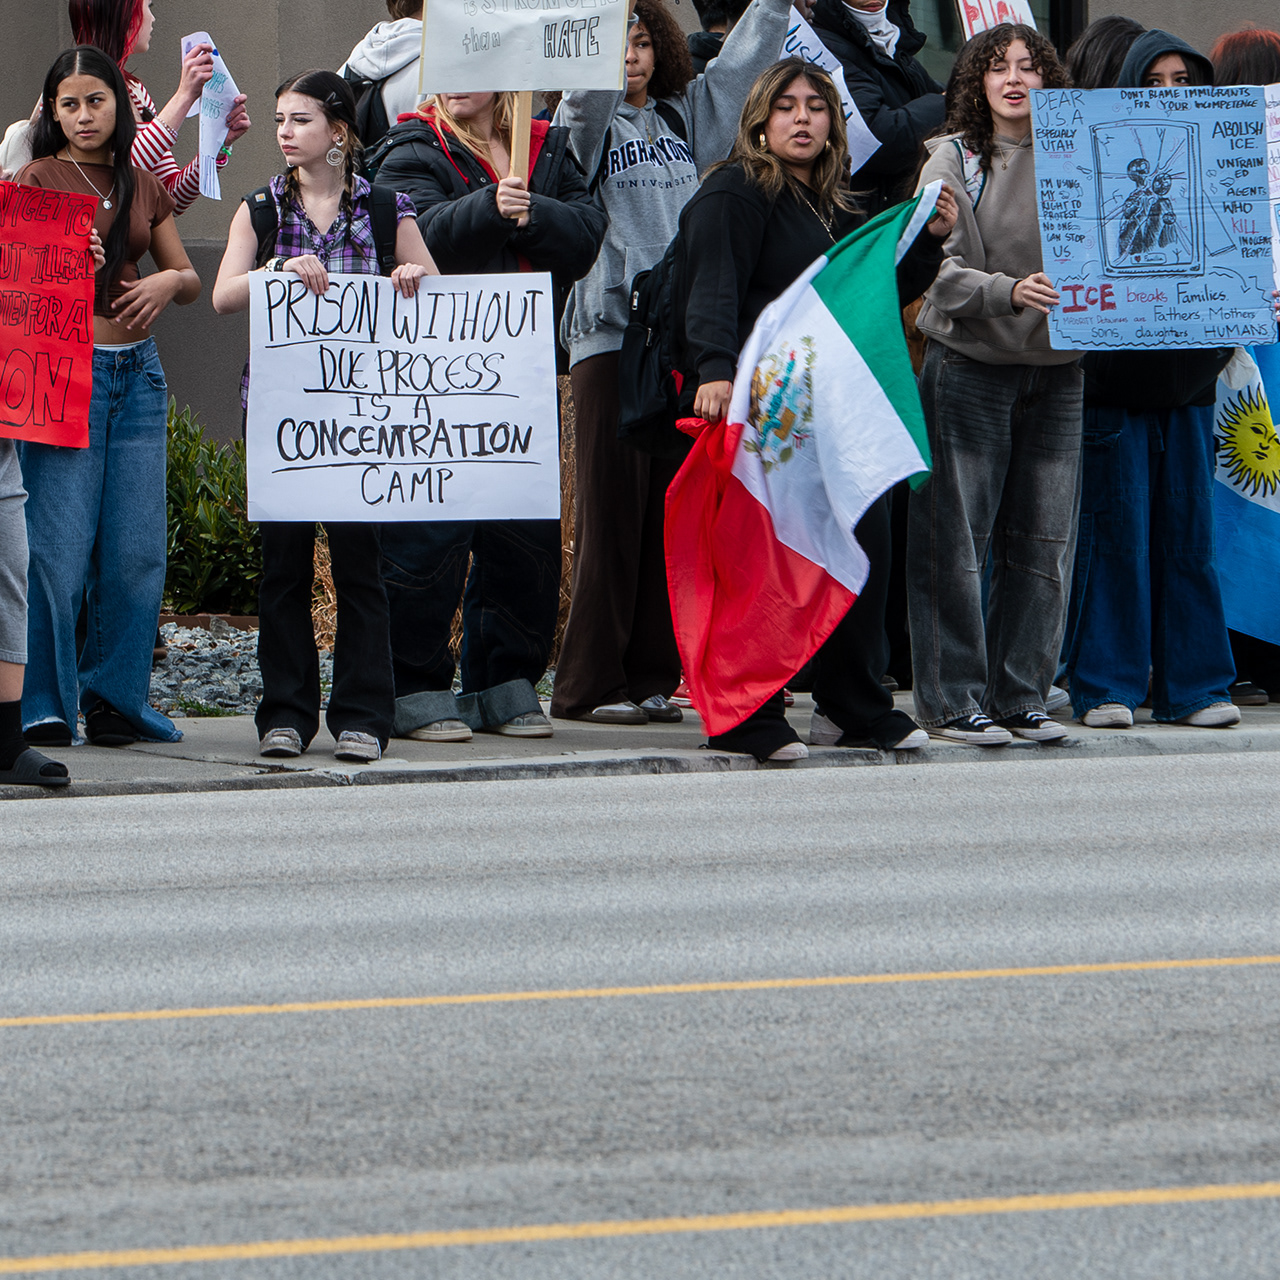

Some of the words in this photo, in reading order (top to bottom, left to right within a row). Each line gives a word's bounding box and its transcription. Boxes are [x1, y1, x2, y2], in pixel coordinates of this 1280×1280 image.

[462, 27, 501, 54] than
[543, 16, 600, 58] HATE
[1035, 89, 1085, 111] DEAR
[1121, 89, 1144, 100] DONT
[1149, 88, 1180, 99] BLAME
[1184, 87, 1250, 98] IMMIGRANTS
[1134, 100, 1150, 109] FOR
[1160, 100, 1188, 110] YOUR
[1212, 120, 1264, 138] ABOLISH
[1041, 140, 1075, 152] UTAH
[1216, 157, 1264, 169] UNTRAIN
[1235, 169, 1249, 178] ED
[1057, 179, 1080, 189] USING
[1040, 190, 1055, 200] MY
[1041, 200, 1069, 211] RIGHT
[1072, 200, 1082, 209] TO
[1223, 201, 1253, 214] WHO
[20, 189, 70, 222] GET
[64, 198, 95, 236] TO
[1043, 222, 1054, 231] NO
[1057, 222, 1072, 231] ONE
[1231, 217, 1259, 234] KILL
[1047, 233, 1062, 242] CAN
[1065, 233, 1085, 243] STOP
[1241, 247, 1272, 258] PEOPLE
[1061, 283, 1116, 313] ICE
[1126, 286, 1168, 303] breaks
[265, 279, 379, 343] PRISON
[391, 290, 544, 344] WITHOUT
[1209, 308, 1256, 320] Mothers
[22, 293, 63, 337] FOR
[59, 299, 90, 344] A
[320, 344, 369, 391] DUE
[375, 349, 505, 395] PROCESS
[349, 395, 391, 422] IS
[412, 394, 432, 426] A
[277, 418, 534, 462] CONCENTRATION
[361, 464, 454, 506] CAMP
